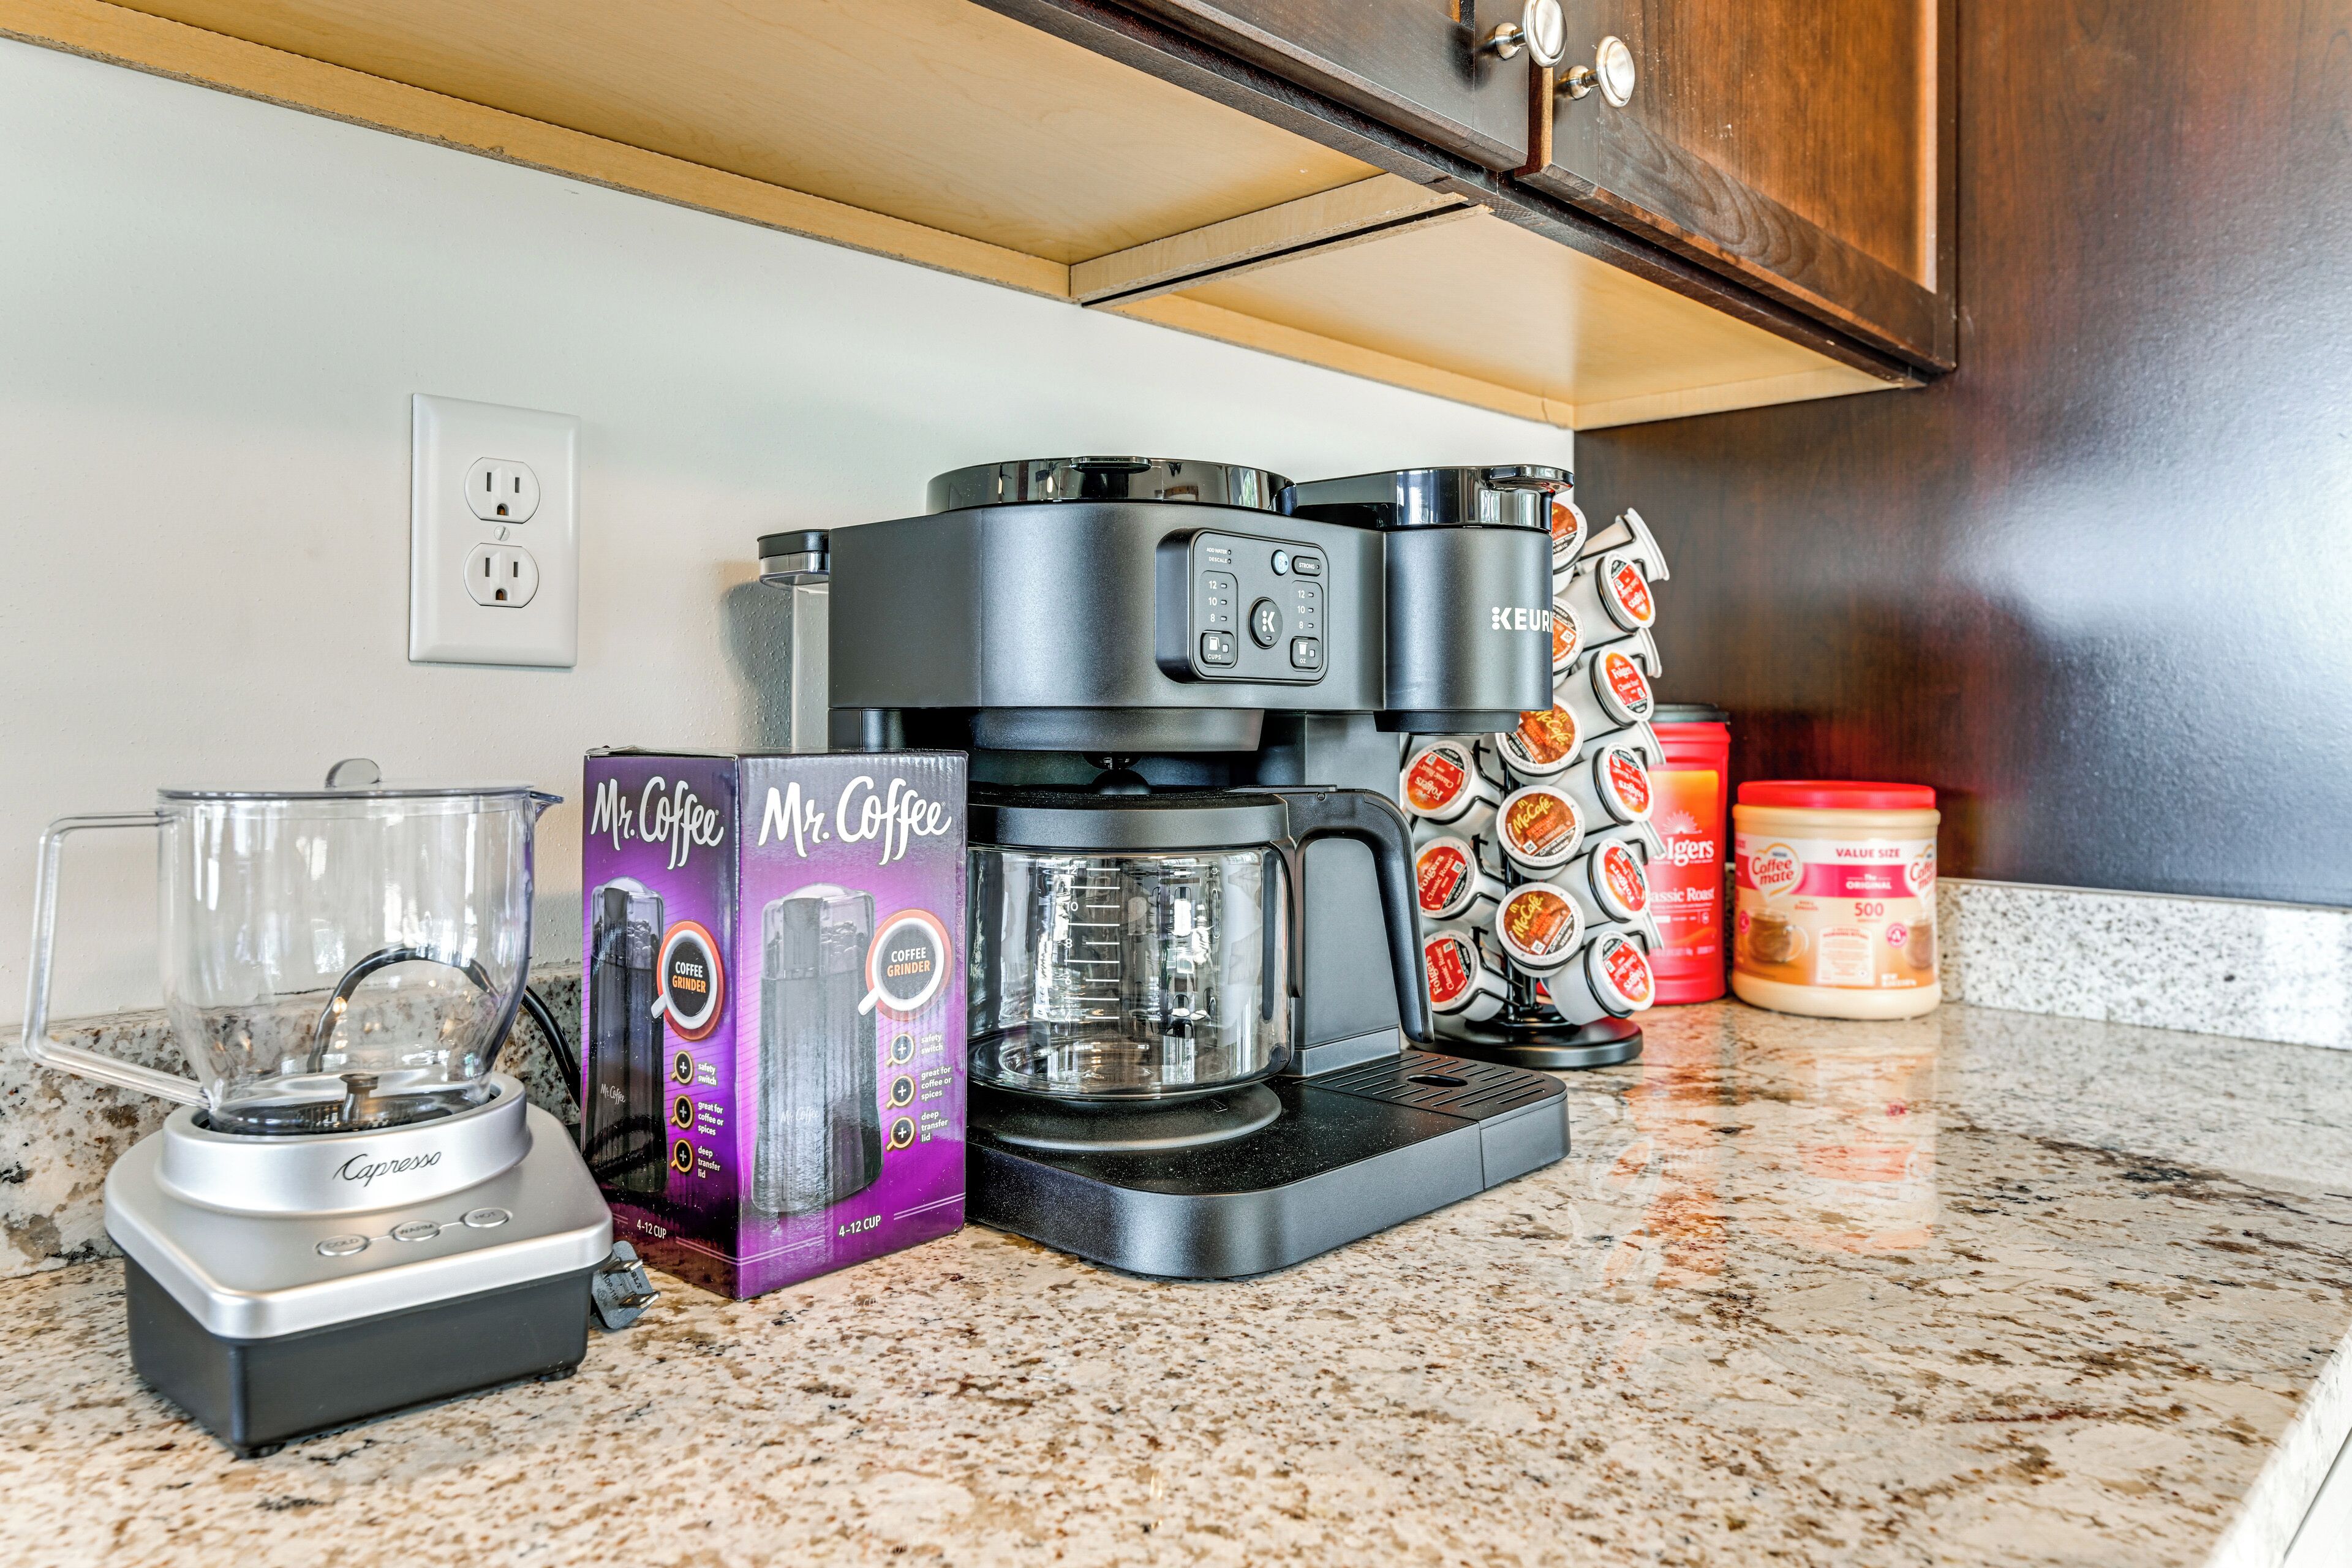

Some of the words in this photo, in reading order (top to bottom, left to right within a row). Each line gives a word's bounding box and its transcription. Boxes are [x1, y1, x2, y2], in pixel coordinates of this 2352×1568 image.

[1209, 581, 1217, 589] 12
[1298, 590, 1305, 598] 12
[1208, 597, 1217, 606] 10
[1210, 614, 1215, 622] 8
[1492, 606, 1552, 633] KEURI
[1298, 621, 1303, 630] 8
[1433, 772, 1454, 789] Classic
[1415, 776, 1444, 801] Folgers
[758, 782, 829, 858] Mr.
[836, 775, 952, 865] Coffee
[1513, 796, 1552, 834] McCafé
[590, 778, 635, 851] Mr.
[639, 776, 724, 870] Coffee
[1654, 837, 1714, 867] lgers
[1836, 848, 1875, 858] VALUE
[1879, 848, 1901, 858] SIZE
[1066, 865, 1078, 875] 12
[1752, 856, 1792, 875] Coffee
[1419, 855, 1444, 893] Folgers
[1426, 876, 1442, 902] Classic
[1438, 856, 1454, 877] Roast
[1760, 870, 1794, 885] mate
[1610, 864, 1635, 903] Folgers
[1845, 881, 1892, 890] ORIGINAL
[1687, 886, 1715, 902] Roast
[1065, 902, 1078, 911] 10
[1855, 902, 1884, 917] 500
[1512, 895, 1542, 939] McCafé
[891, 947, 926, 963] COFFEE
[1435, 948, 1446, 967] Roast
[676, 961, 703, 978] COFFEE
[887, 960, 930, 978] GRINDER
[1426, 956, 1443, 995] Folgers
[673, 975, 706, 993] GRINDER
[1442, 965, 1454, 990] Classic
[1623, 967, 1645, 991] Folgers
[921, 1034, 942, 1044] safety
[921, 1044, 943, 1055] switch
[698, 1063, 715, 1075] safety
[921, 1068, 940, 1080] great
[698, 1074, 717, 1086] switch
[921, 1078, 942, 1089] coffee
[600, 1084, 609, 1099] Mr.
[610, 1085, 625, 1105] Coffee
[921, 1090, 943, 1101] spices
[698, 1102, 714, 1111] great
[714, 1105, 723, 1114] for
[698, 1113, 716, 1123] coffee
[780, 1110, 794, 1125] Mr.
[796, 1106, 821, 1126] Coffee
[921, 1111, 940, 1121] deep
[698, 1125, 716, 1136] spices
[921, 1118, 948, 1132] transfer
[921, 1133, 931, 1142] lid
[698, 1145, 713, 1159] deep
[332, 1152, 442, 1187] Capresso
[698, 1158, 721, 1171] transfer
[698, 1168, 706, 1179] lid
[473, 1211, 497, 1220] HOT
[401, 1224, 434, 1235] WARM
[637, 1219, 653, 1235] 4-12
[654, 1225, 667, 1239] CUP
[839, 1220, 861, 1237] 4-12
[864, 1215, 881, 1230] CUP
[326, 1238, 359, 1248] COLD
